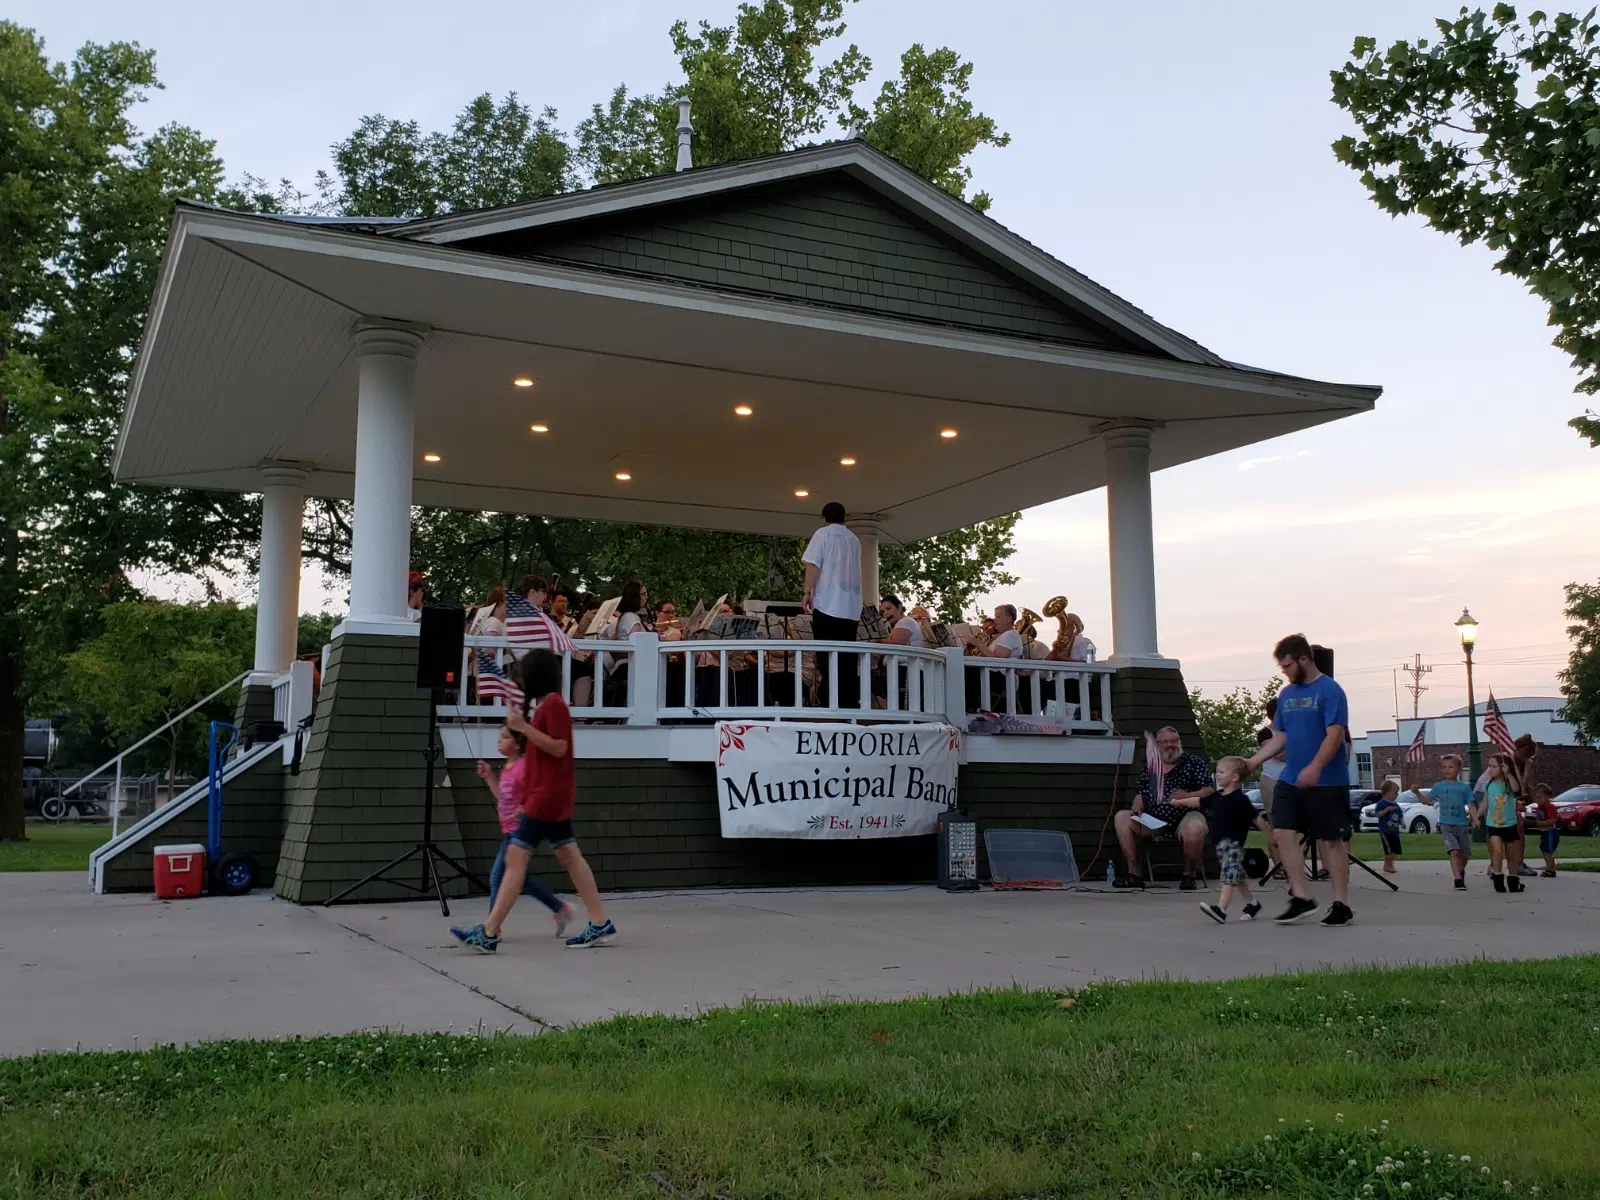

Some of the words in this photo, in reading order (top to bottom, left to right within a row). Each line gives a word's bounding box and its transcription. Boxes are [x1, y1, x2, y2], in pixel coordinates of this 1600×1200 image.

[795, 730, 921, 756] EMPORIA
[722, 764, 896, 811] Municipal
[904, 766, 958, 808] Band
[829, 815, 853, 830] Est.
[859, 815, 889, 829] 1941
